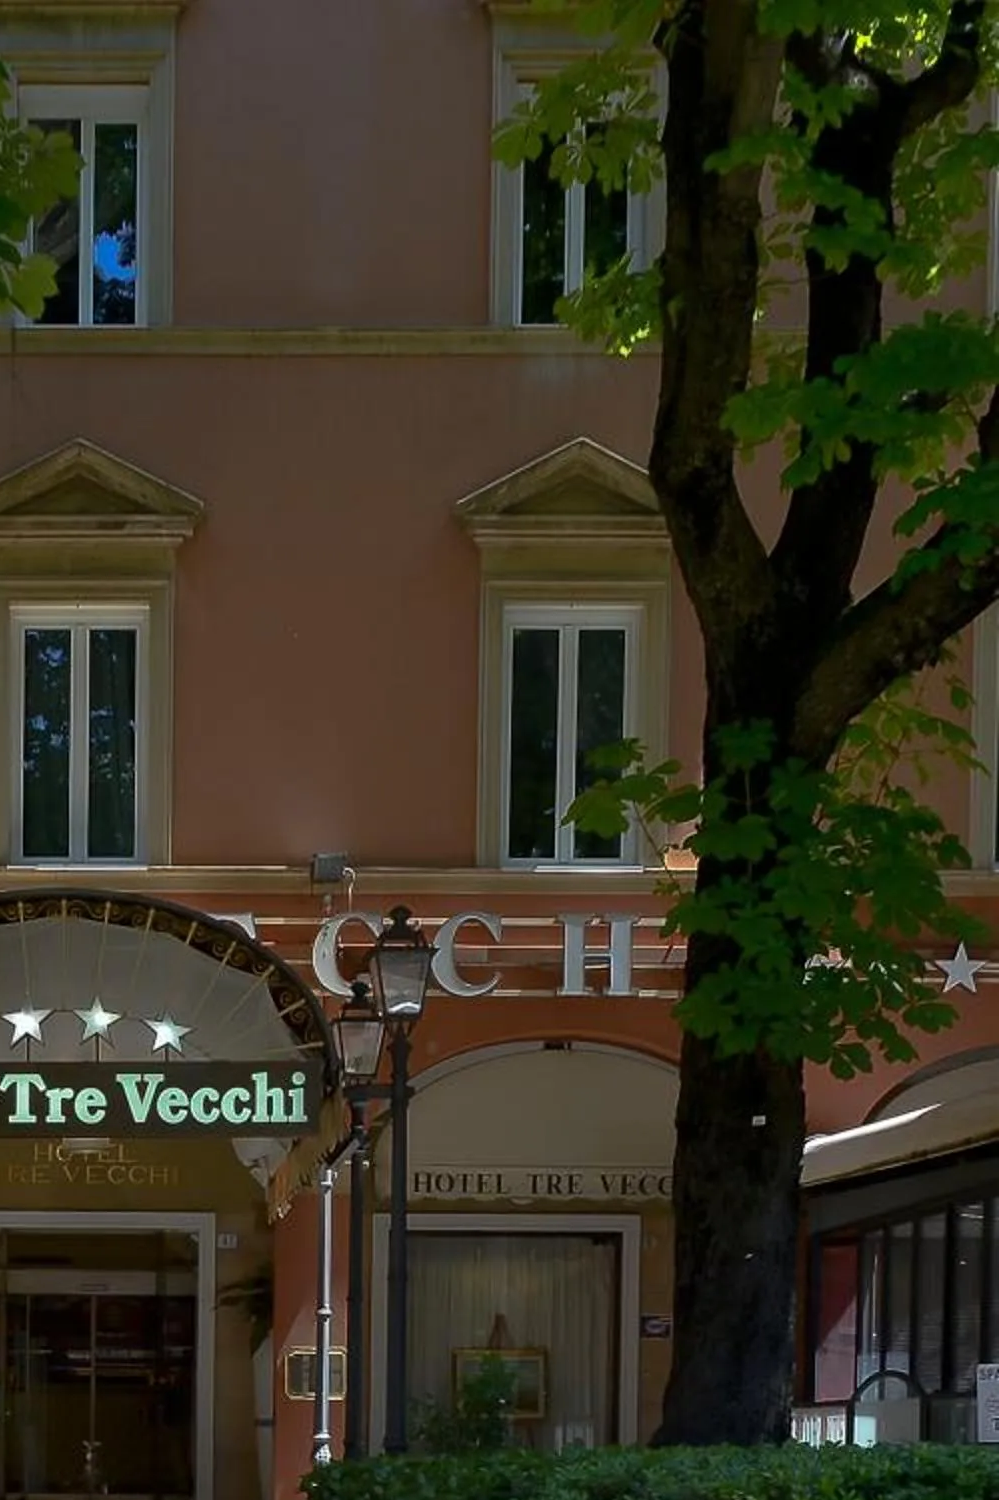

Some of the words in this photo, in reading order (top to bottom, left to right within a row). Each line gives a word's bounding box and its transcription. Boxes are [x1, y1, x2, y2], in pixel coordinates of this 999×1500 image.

[0, 1073, 108, 1125] Tre
[116, 1071, 308, 1124] Vecchi
[413, 1172, 511, 1194] HOTEL
[527, 1173, 585, 1195] TRE
[600, 1174, 675, 1196] VECC
